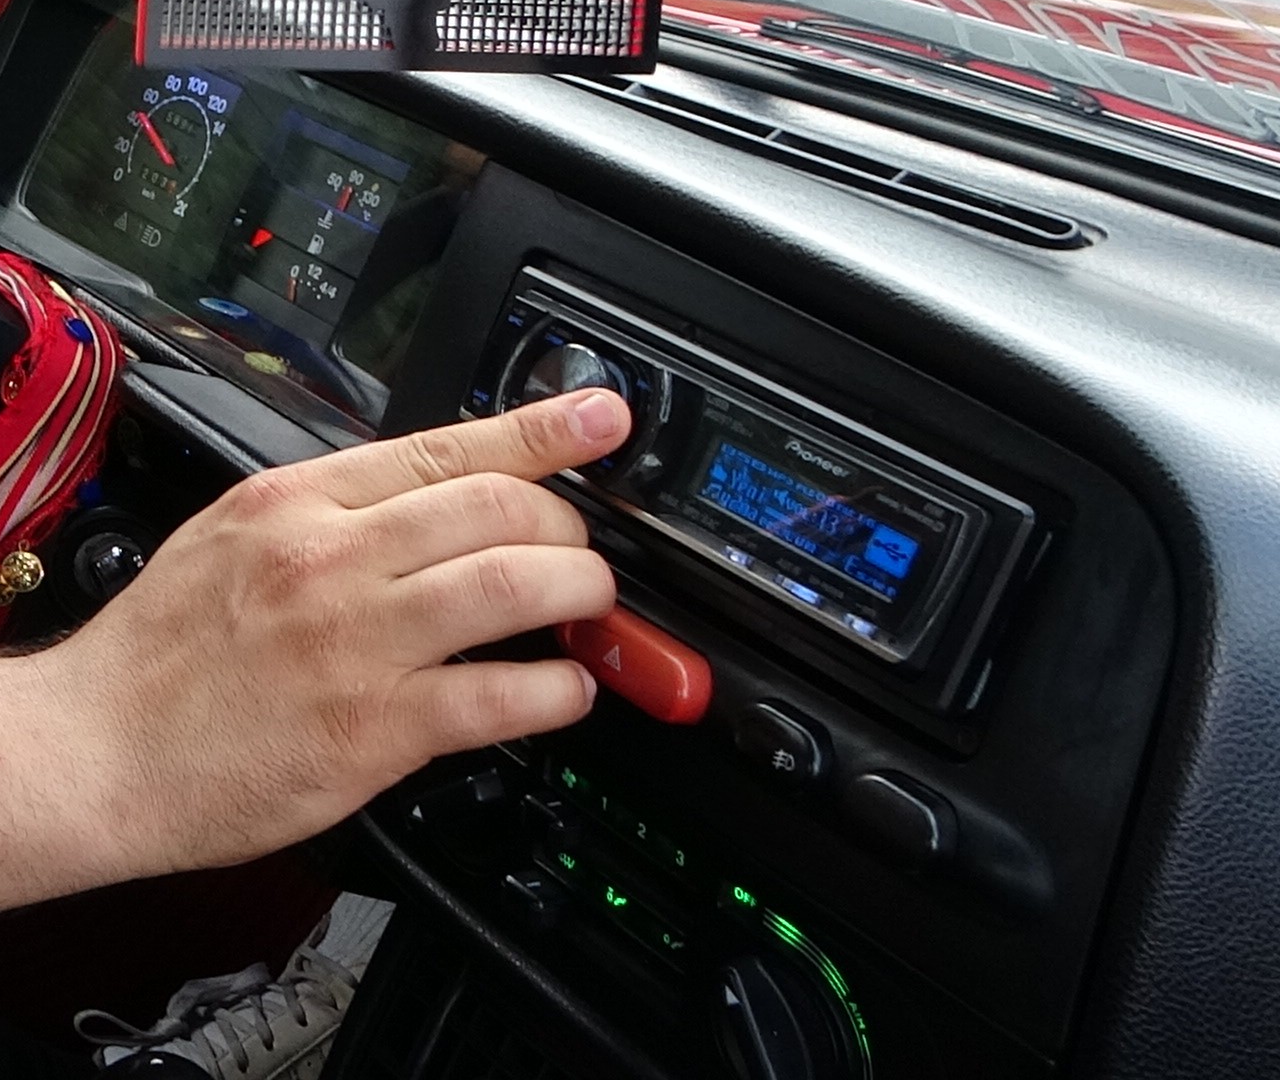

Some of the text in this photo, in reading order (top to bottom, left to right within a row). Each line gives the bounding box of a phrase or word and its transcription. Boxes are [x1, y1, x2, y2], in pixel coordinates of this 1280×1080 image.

[165, 74, 181, 92] 80
[187, 76, 208, 96] 100
[143, 88, 159, 104] 60
[207, 95, 227, 114] 120
[114, 136, 129, 153] 20
[113, 167, 123, 181] 0
[327, 172, 343, 188] 50
[349, 170, 365, 186] 90
[361, 190, 380, 208] 130
[290, 264, 300, 278] 0
[785, 440, 851, 477] Pioneer
[637, 822, 646, 840] 2
[675, 850, 684, 866] 3
[734, 886, 756, 907] OFF
